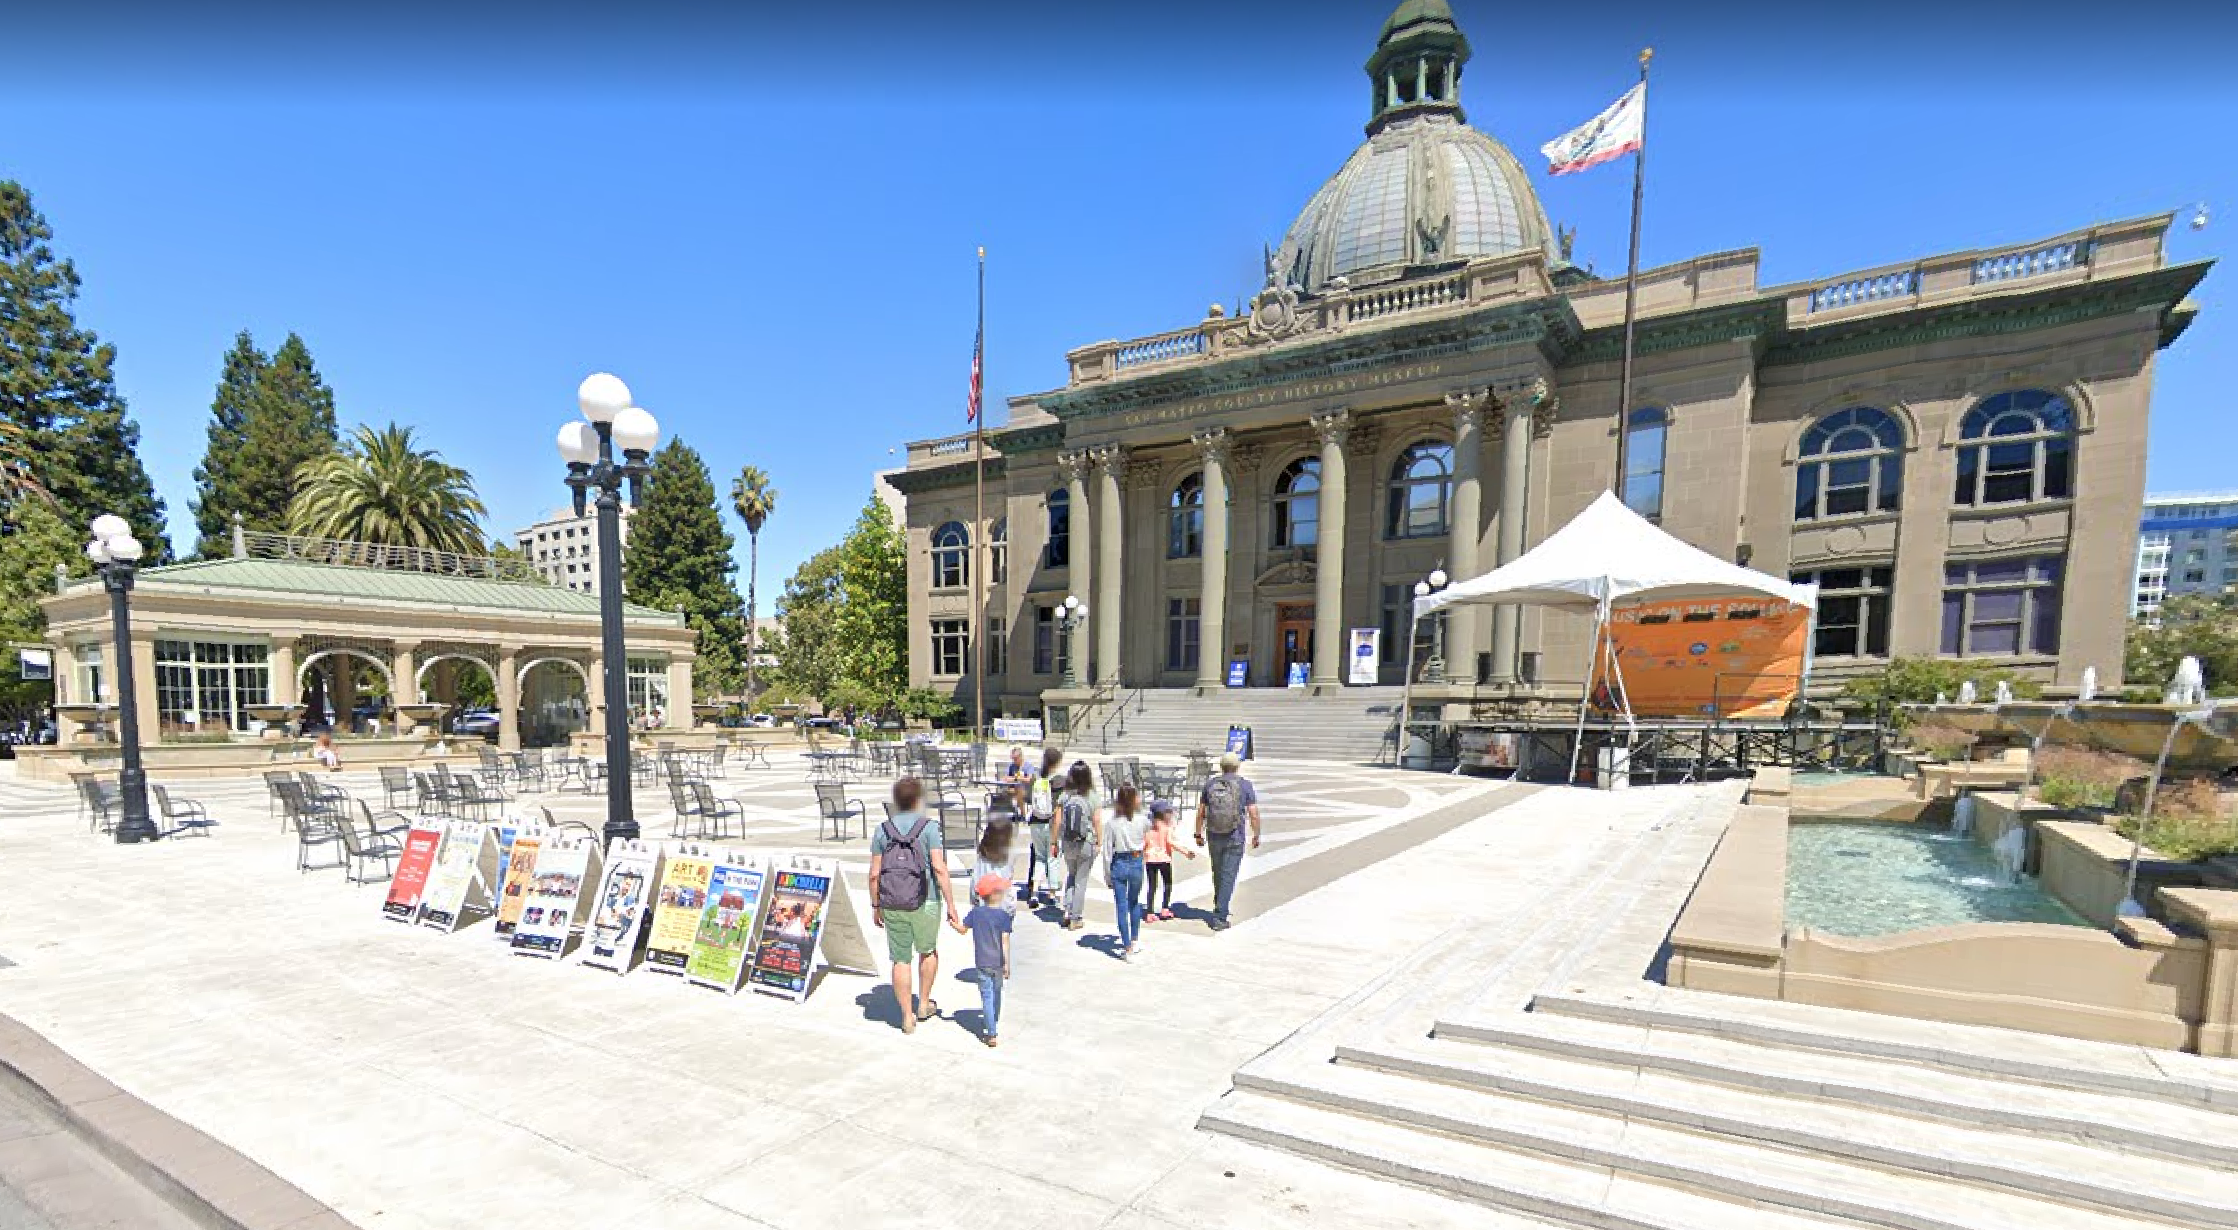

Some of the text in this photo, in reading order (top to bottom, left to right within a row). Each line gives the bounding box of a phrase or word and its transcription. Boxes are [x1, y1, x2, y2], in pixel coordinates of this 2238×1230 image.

[1213, 390, 1276, 411] COUNTY
[1285, 377, 1358, 400] HISTORY
[1368, 364, 1440, 385] MUSEUM
[672, 862, 694, 875] ART
